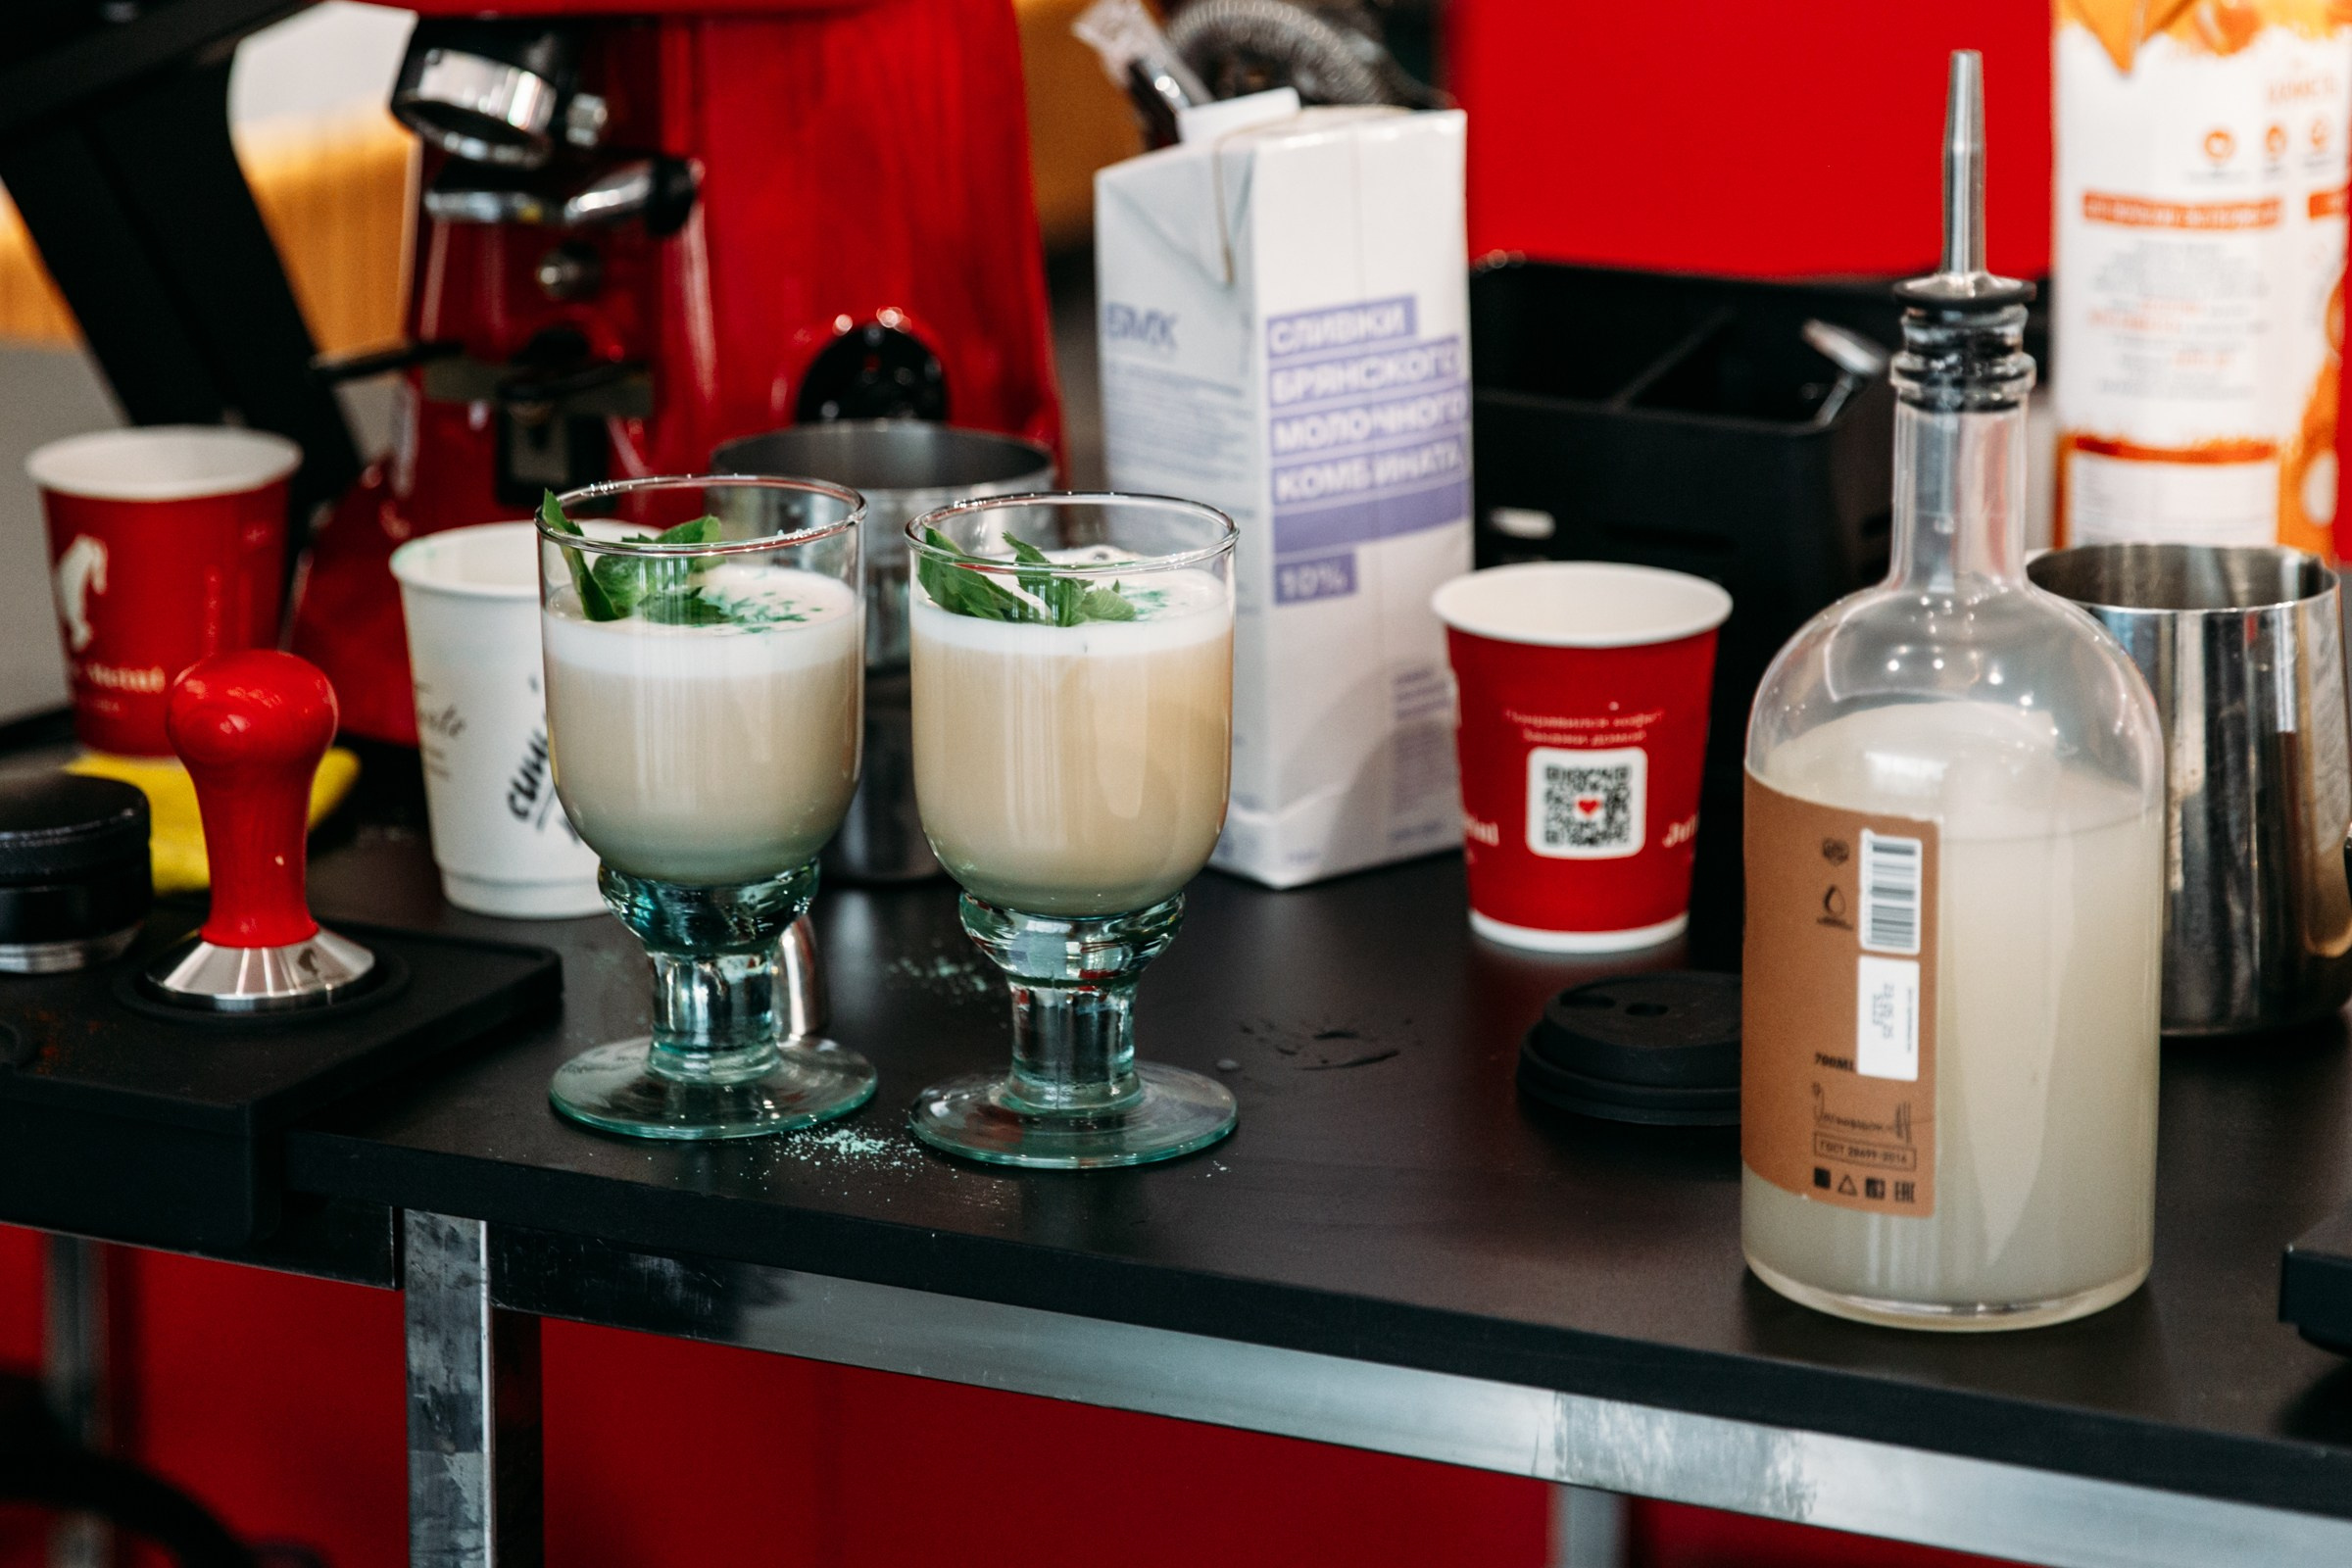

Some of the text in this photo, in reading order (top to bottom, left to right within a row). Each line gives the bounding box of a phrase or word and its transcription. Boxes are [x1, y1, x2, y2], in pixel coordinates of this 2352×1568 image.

[1270, 302, 1405, 354] СЛИВКИ
[1274, 389, 1467, 450] МОЛОЧНОГО
[1281, 560, 1348, 599] 10%
